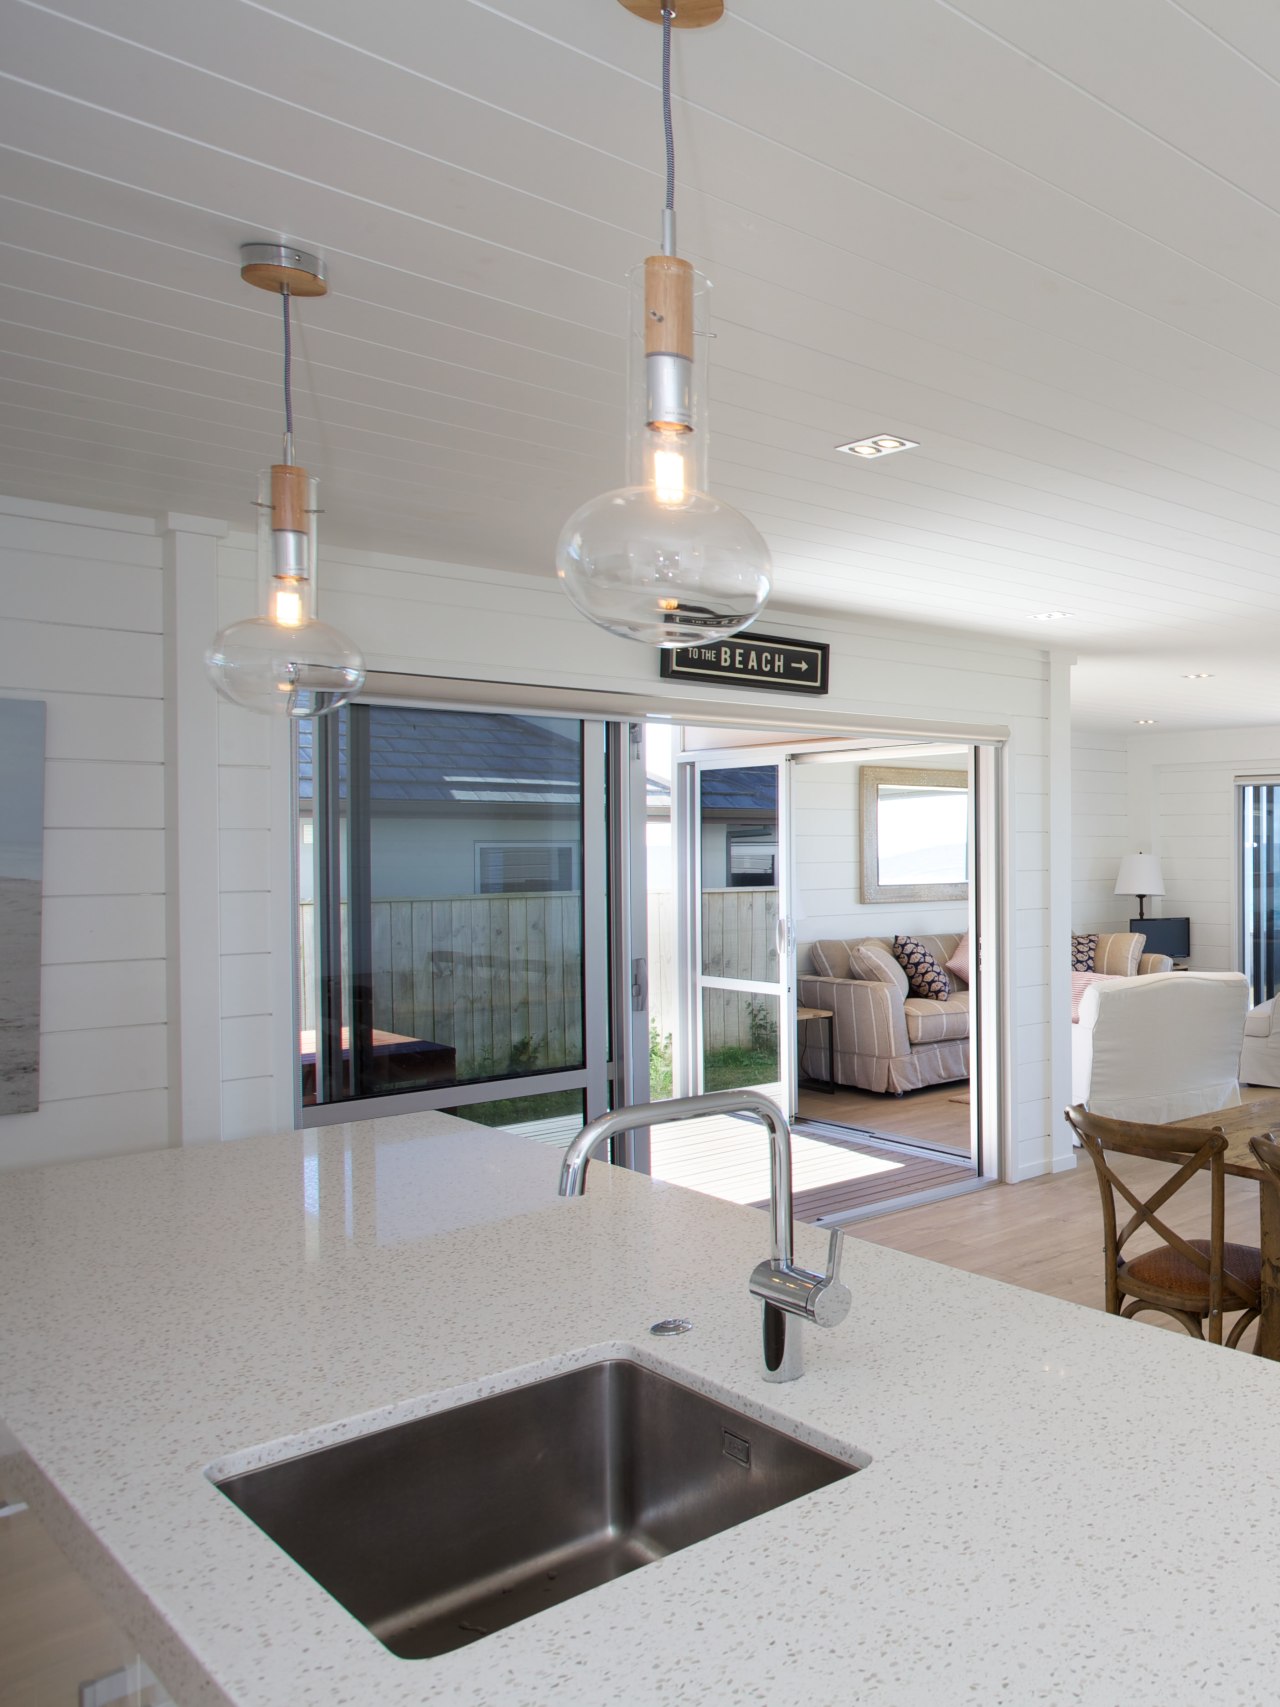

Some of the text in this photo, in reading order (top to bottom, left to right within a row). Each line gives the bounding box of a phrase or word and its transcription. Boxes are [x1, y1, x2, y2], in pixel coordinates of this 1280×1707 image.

[687, 646, 784, 674] TO THE BEACH
